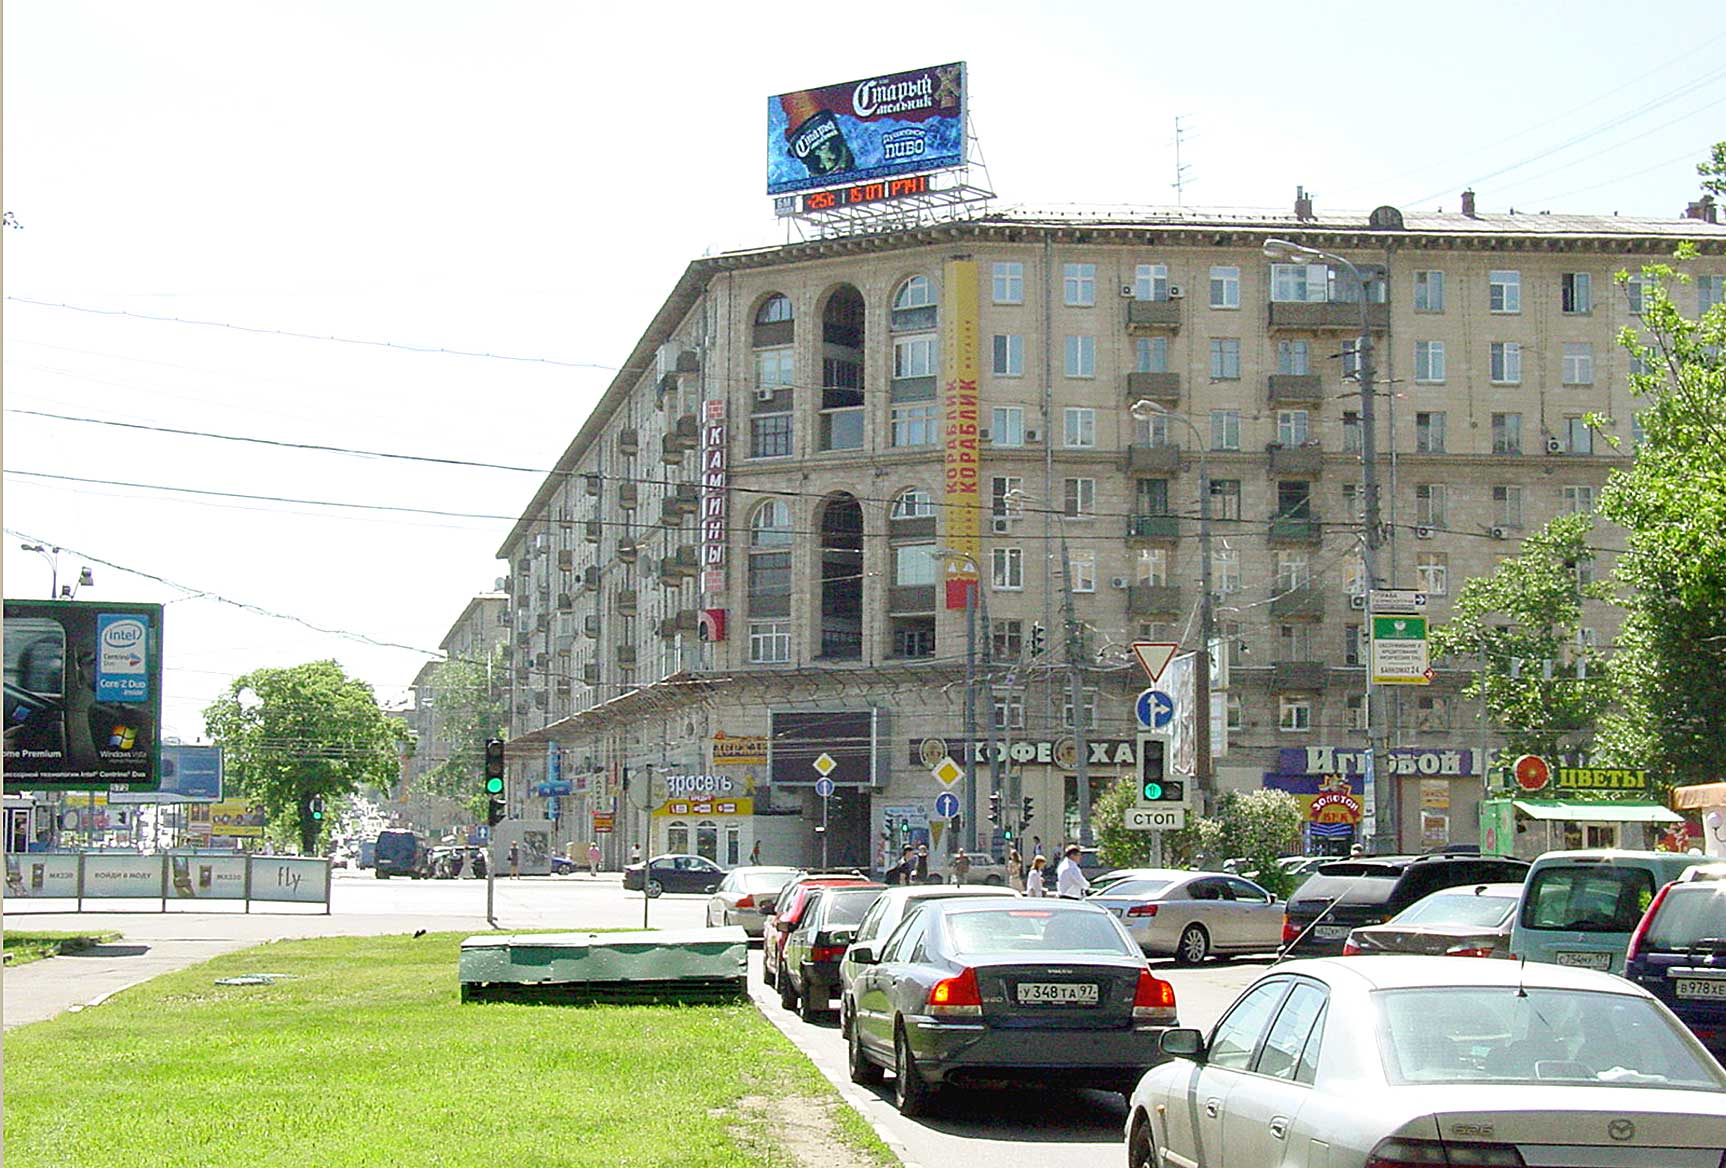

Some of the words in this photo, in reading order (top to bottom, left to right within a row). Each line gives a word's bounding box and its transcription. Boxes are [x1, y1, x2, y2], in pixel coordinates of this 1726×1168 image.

[960, 378, 977, 494] КОРАБЛИК
[708, 427, 722, 564] КАМИНЫ
[109, 629, 136, 641] intel
[100, 679, 119, 688] Core
[128, 679, 146, 689] Duo
[22, 749, 62, 758] Premium
[1559, 769, 1646, 788] ЦВЕТЫ
[1134, 813, 1175, 825] СТОП
